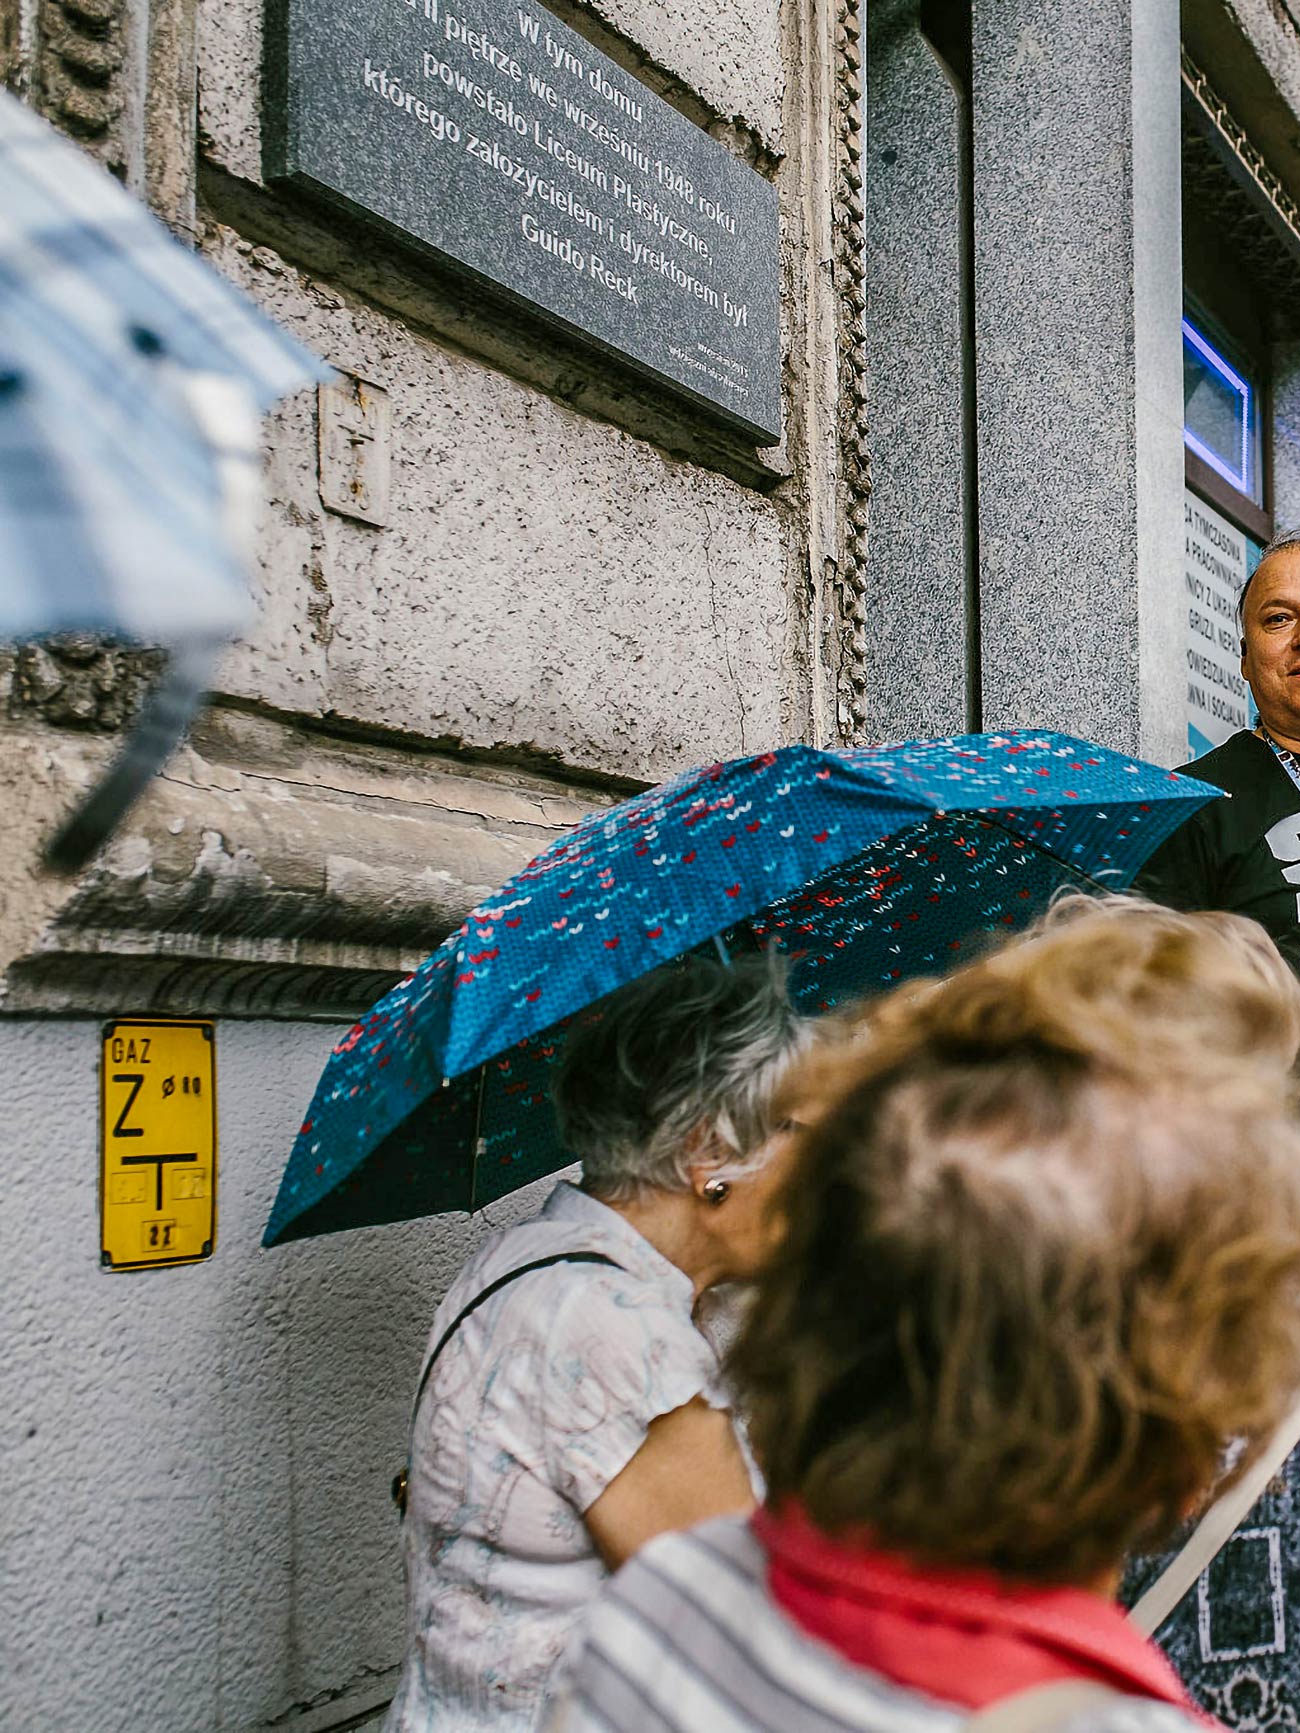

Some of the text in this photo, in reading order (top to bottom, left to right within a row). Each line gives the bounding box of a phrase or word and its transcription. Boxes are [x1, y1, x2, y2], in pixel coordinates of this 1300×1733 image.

[517, 7, 642, 123] W tym domu
[423, 51, 713, 266] powstało Liceum Plastyczne,
[446, 13, 522, 83] piętrze
[529, 73, 558, 108] we
[564, 98, 649, 174] wrześniu
[654, 160, 694, 205] 1948
[700, 195, 735, 235] roku
[364, 58, 749, 328] którego założycielem i dyrektorem był
[522, 213, 638, 304] Guido Reck
[112, 1038, 152, 1064] GAZ
[112, 1074, 144, 1138] Z
